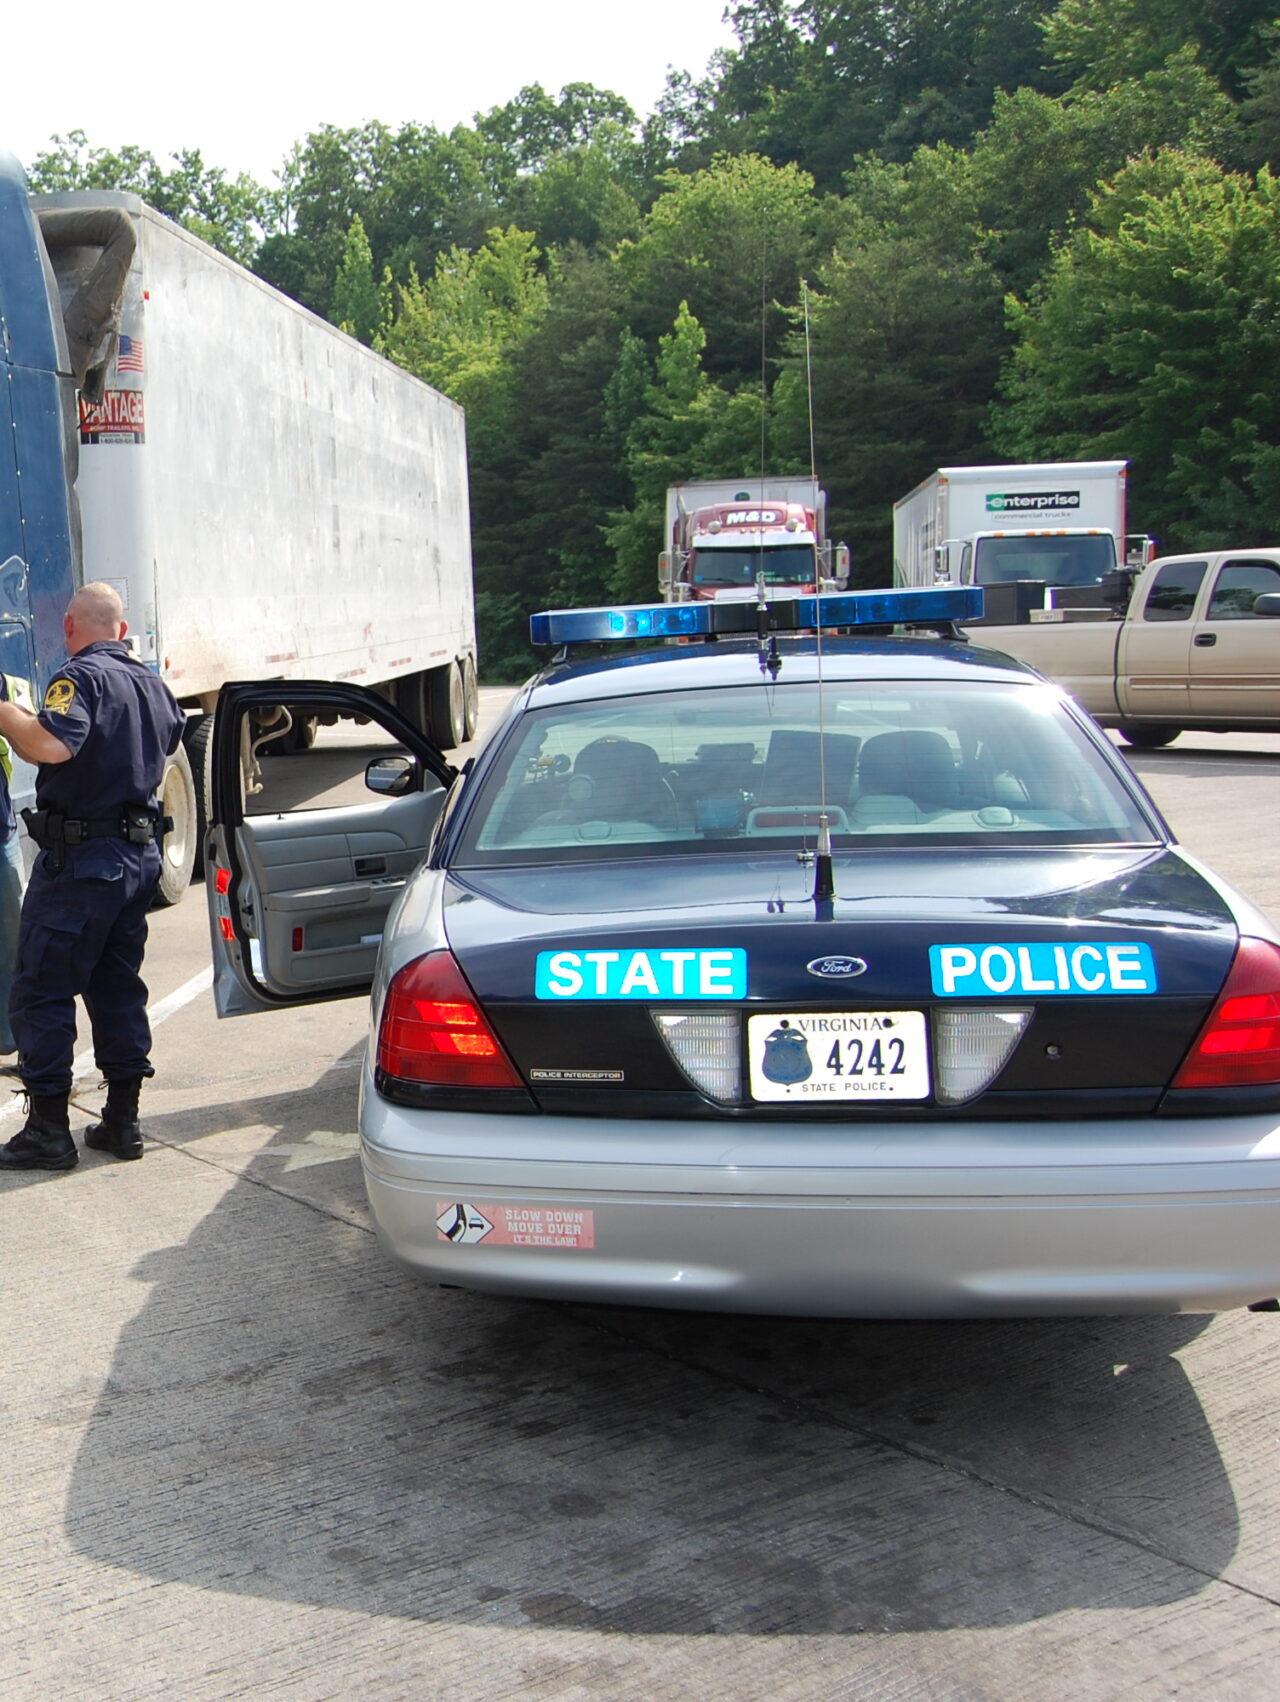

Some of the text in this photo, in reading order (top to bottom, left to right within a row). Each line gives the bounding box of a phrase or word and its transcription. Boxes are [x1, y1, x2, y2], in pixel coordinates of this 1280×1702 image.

[987, 494, 1079, 508] enterprise
[726, 511, 776, 525] M&D
[547, 951, 734, 996] STATE
[821, 960, 853, 973] Ford
[940, 945, 1147, 993] POLICE
[798, 1017, 884, 1032] VIRGINIA
[826, 1037, 906, 1076] 4242
[563, 1071, 621, 1079] INTERCEPTOR
[802, 1082, 887, 1092] STATE POLICE
[505, 1209, 584, 1223] SLOW DOWN
[507, 1221, 582, 1235] MOVE OVER
[532, 1235, 552, 1245] THE
